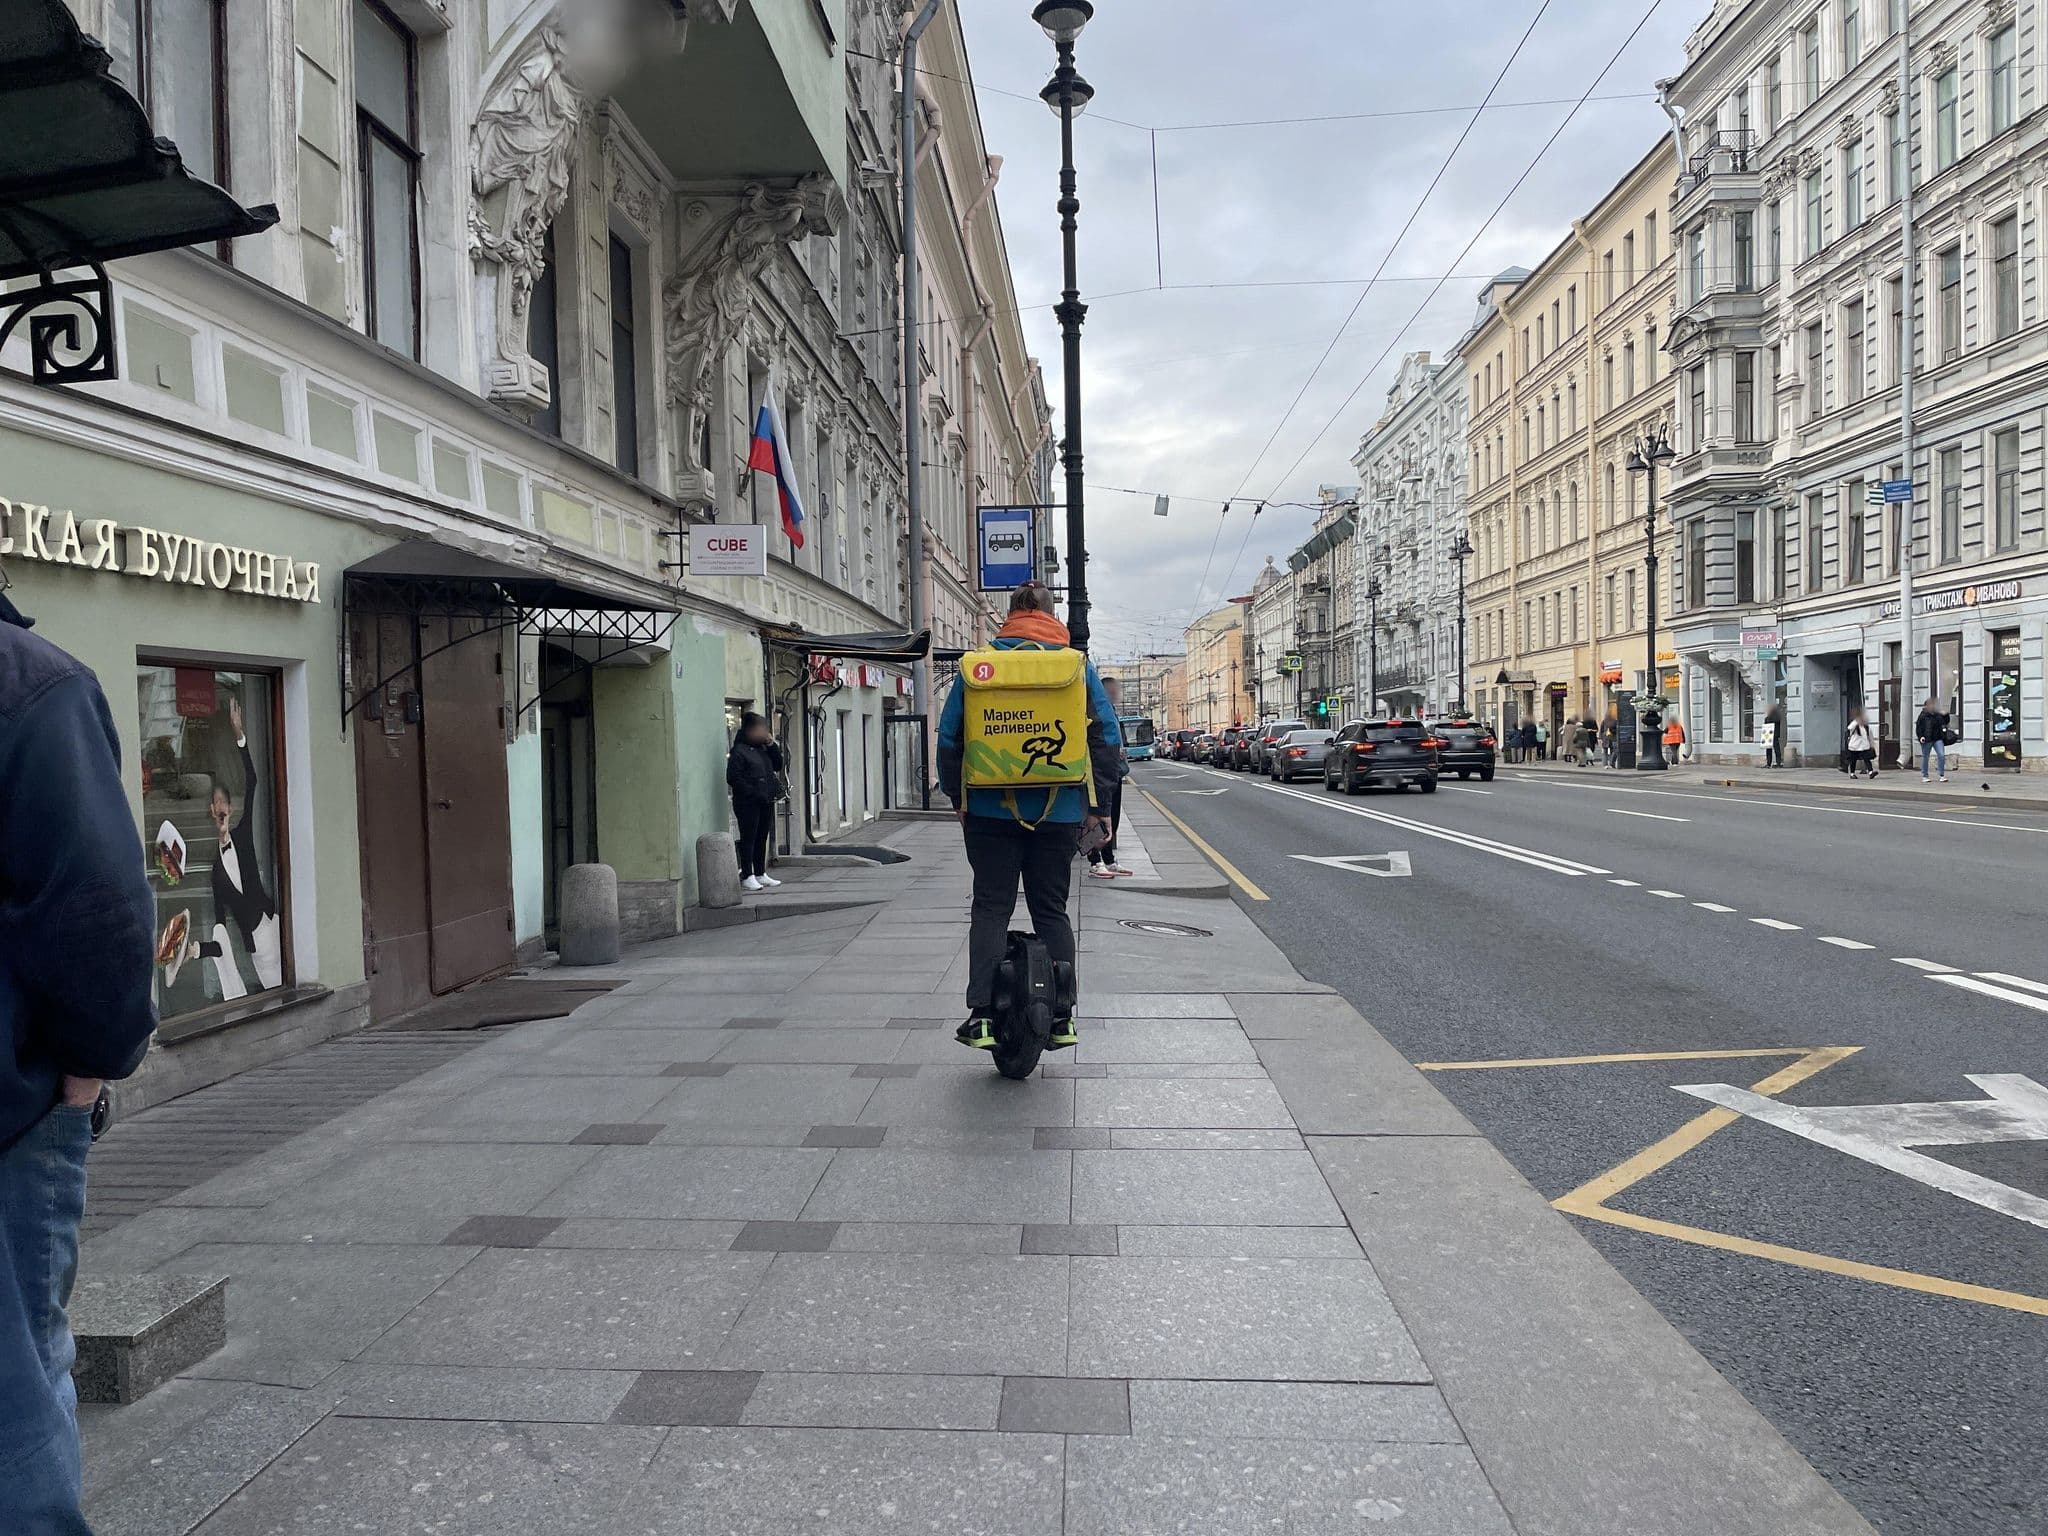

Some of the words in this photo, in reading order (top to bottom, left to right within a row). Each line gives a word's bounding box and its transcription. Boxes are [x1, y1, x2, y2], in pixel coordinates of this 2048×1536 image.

[707, 538, 748, 552] CUBE
[138, 526, 321, 604] БУЛОЧНАЯ
[1922, 590, 1963, 612] ТРИКОТАЖ
[1977, 581, 2018, 601] ИВАНОВО
[978, 665, 988, 679] Я
[983, 708, 1034, 723] Маркет
[984, 722, 1050, 736] деливери
